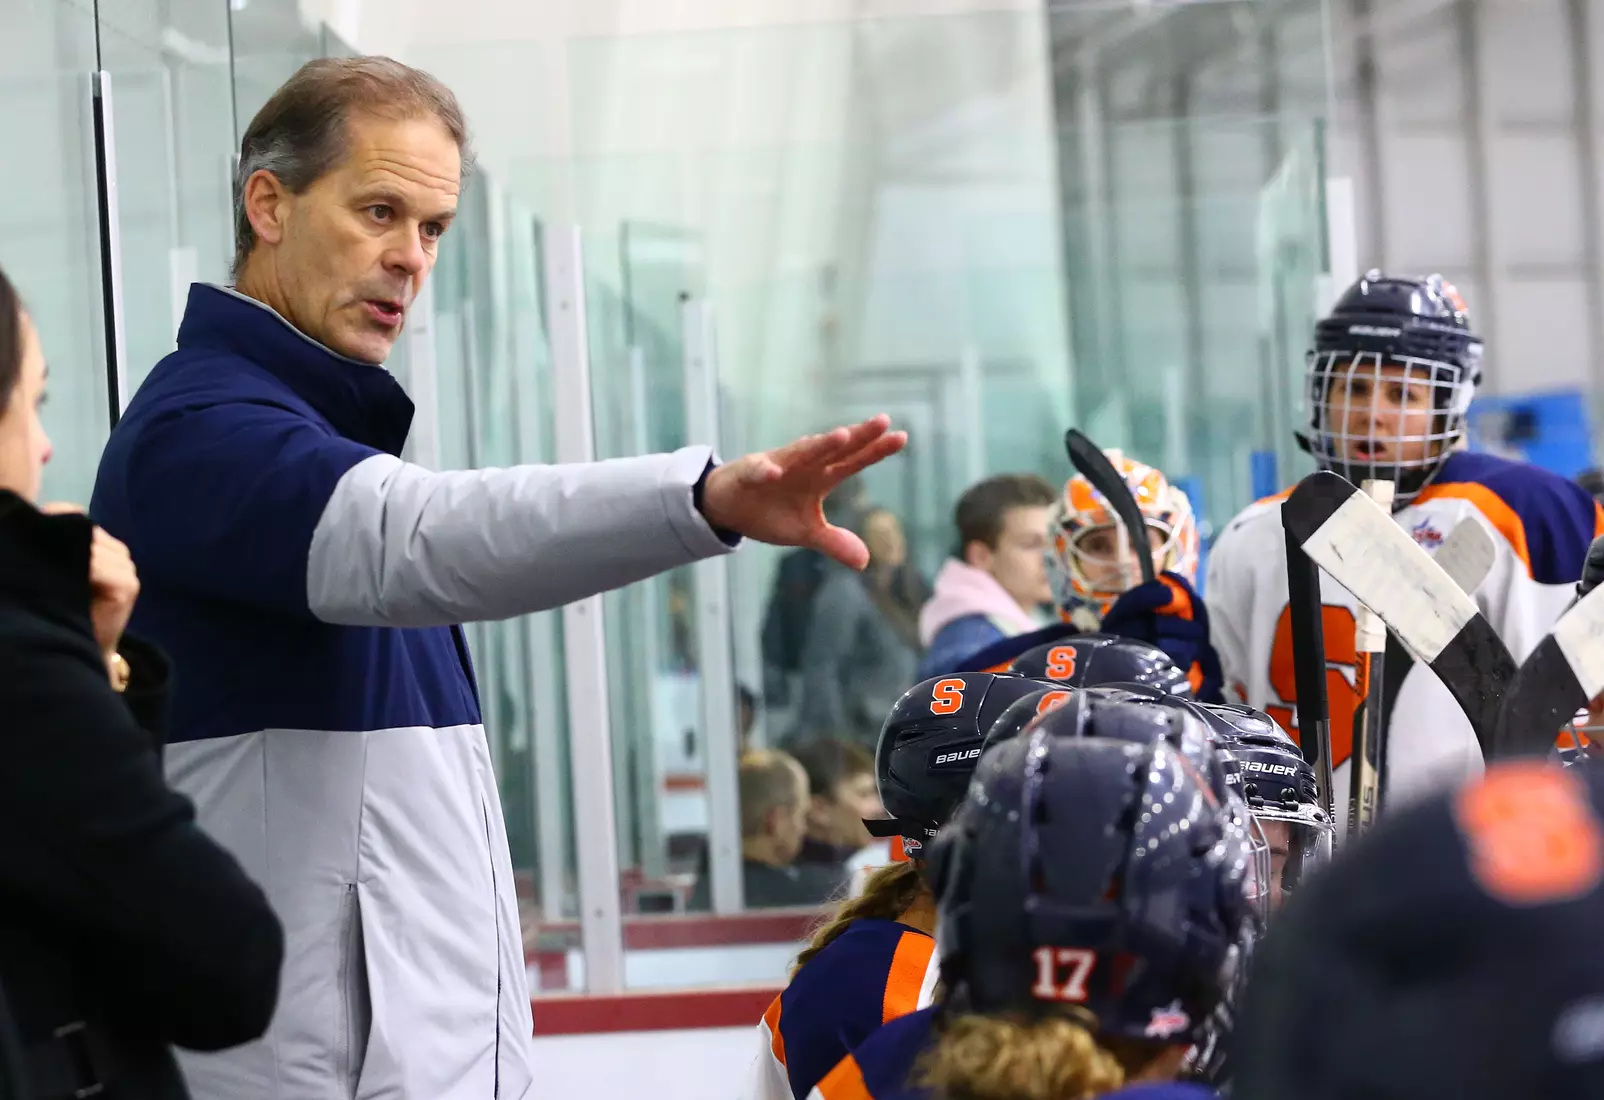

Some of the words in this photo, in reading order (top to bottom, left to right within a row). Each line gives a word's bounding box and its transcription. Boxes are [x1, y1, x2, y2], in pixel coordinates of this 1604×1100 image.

[1046, 645, 1077, 680] S
[930, 678, 966, 715] S
[936, 749, 980, 764] BAUE
[1032, 946, 1098, 1000] 17
